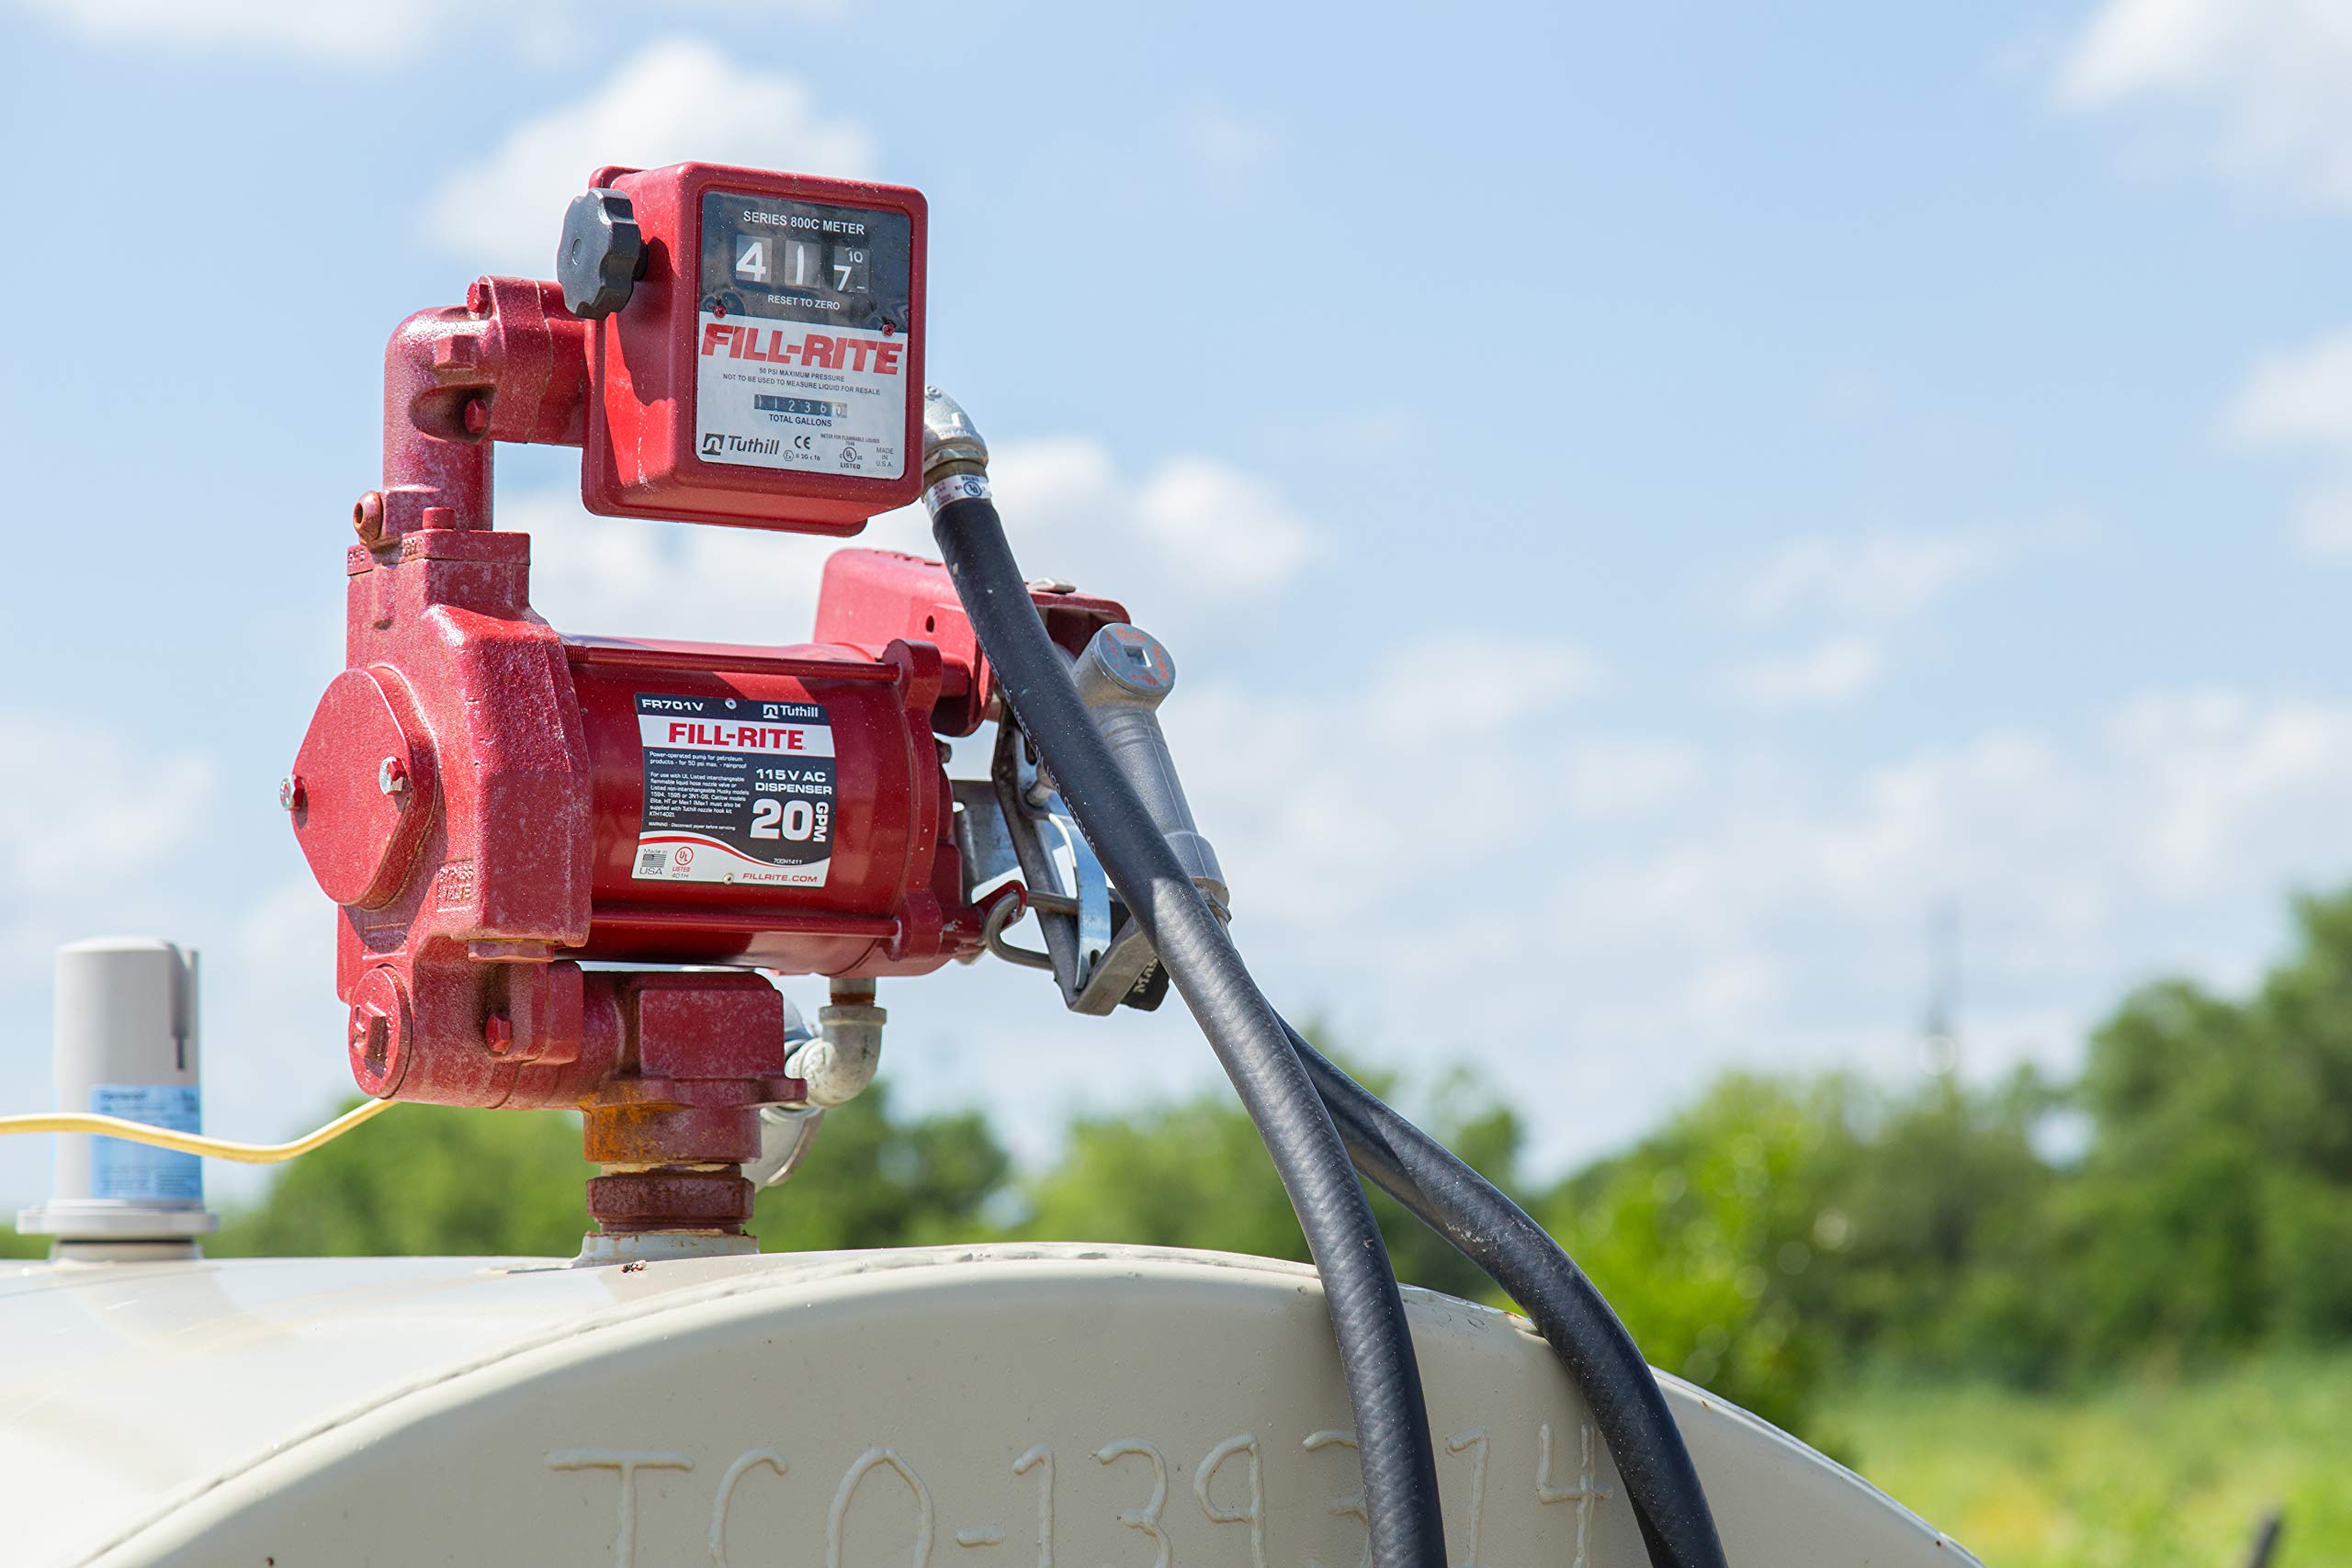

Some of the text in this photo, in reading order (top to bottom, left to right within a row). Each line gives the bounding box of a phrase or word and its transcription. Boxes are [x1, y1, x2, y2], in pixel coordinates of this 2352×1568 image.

[743, 211, 865, 235] SERIES 800C METER
[768, 295, 840, 310] RESET TO ZERO
[701, 323, 903, 375] FILL-RITE
[779, 369, 810, 378] MAXIMUM
[811, 373, 844, 382] PRESSURE
[786, 379, 817, 389] MEASURE
[819, 383, 840, 391] LIQUID
[855, 387, 880, 395] RESALE
[769, 413, 831, 427] TOTAL GALLONS
[729, 435, 779, 455] Tuthill
[794, 435, 810, 450] CE
[641, 699, 704, 711] FR701V
[780, 705, 818, 717] Tuthill
[669, 722, 804, 750] FILL-RITE
[802, 772, 826, 782] AC
[755, 783, 832, 795] DISPENSER
[750, 798, 829, 842] 20 GPM
[743, 873, 818, 882] FILLRITE.COM
